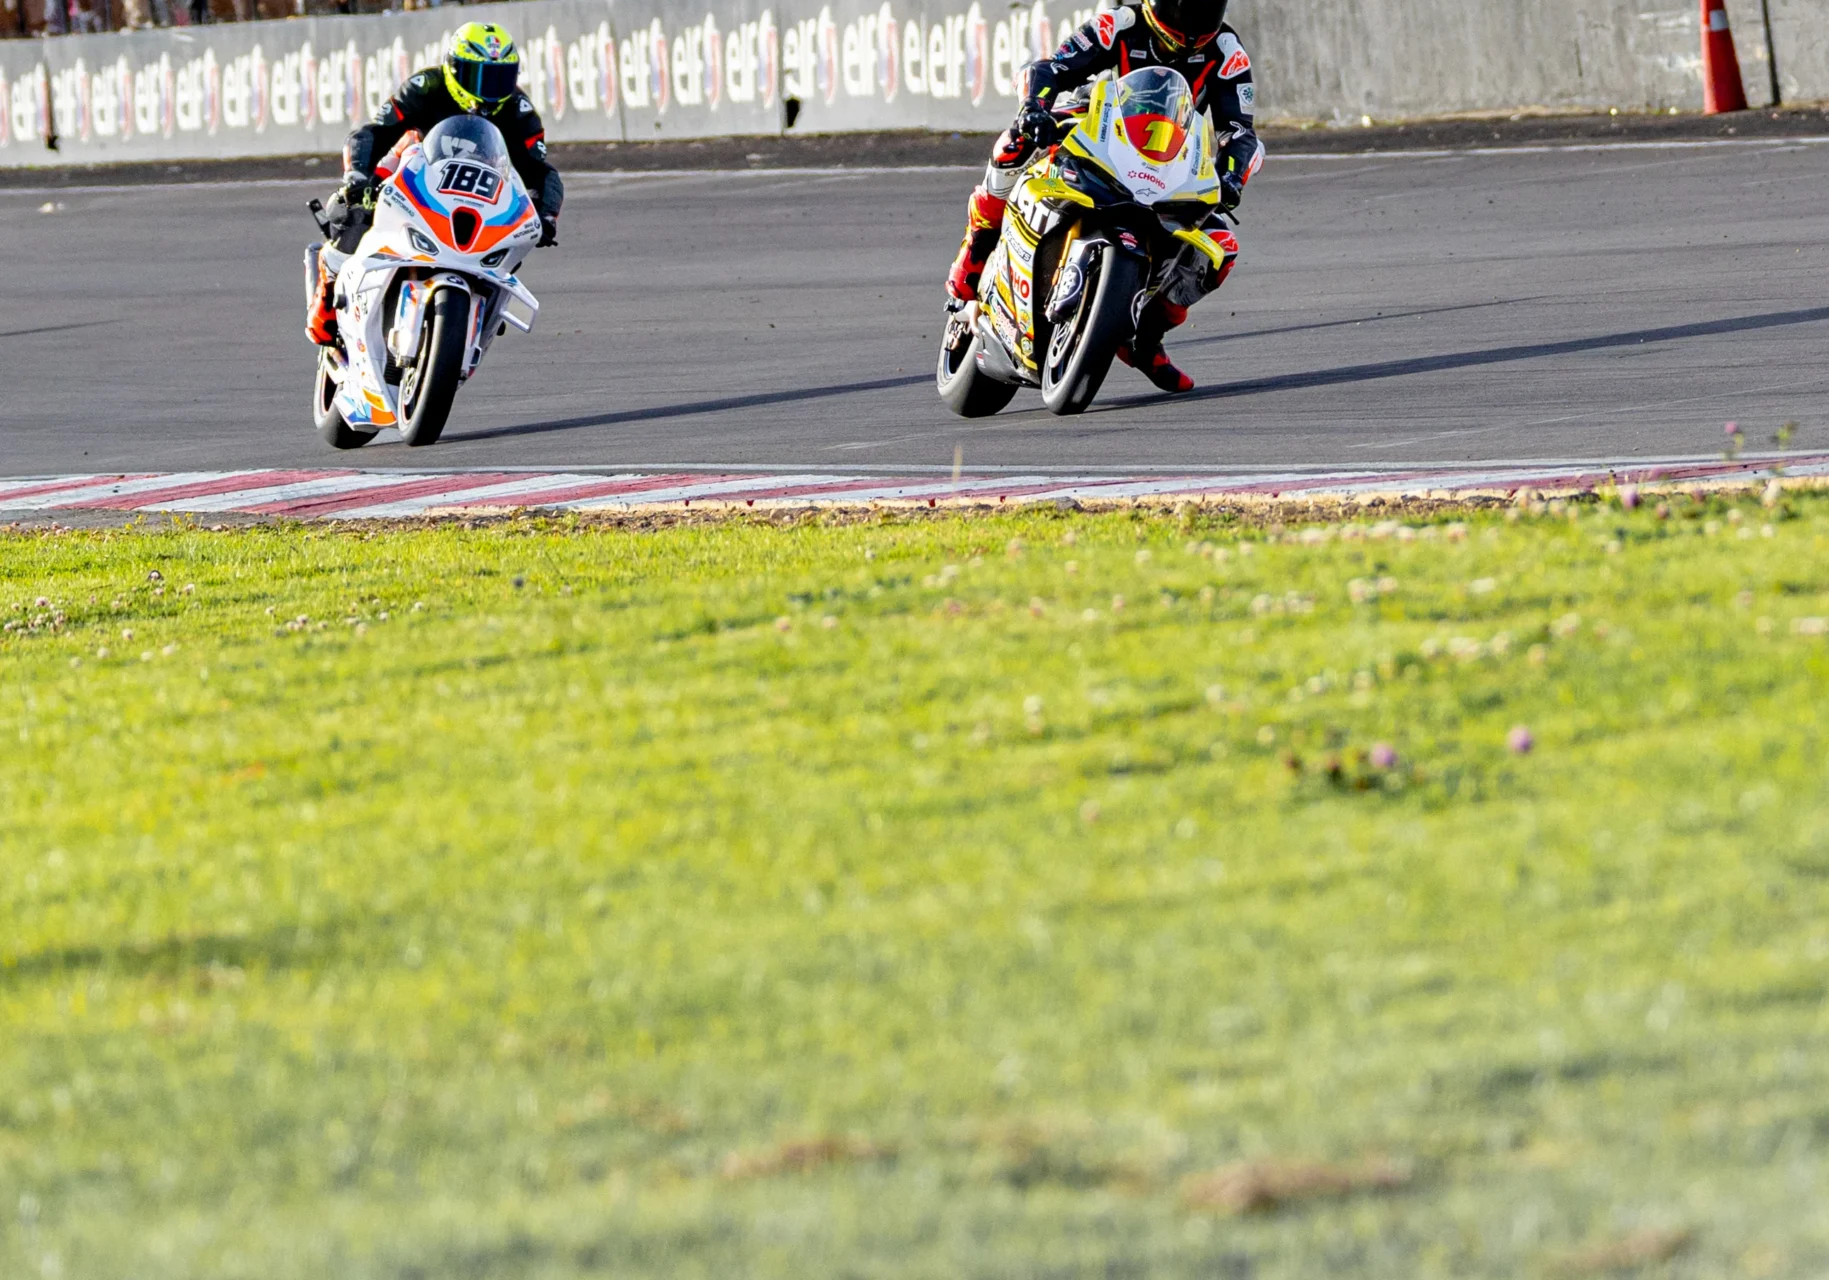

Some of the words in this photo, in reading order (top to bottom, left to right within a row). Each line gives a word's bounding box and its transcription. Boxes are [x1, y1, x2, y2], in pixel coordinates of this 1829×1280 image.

[1142, 121, 1175, 153] 1
[438, 162, 502, 200] 189
[1137, 171, 1167, 190] CHOHO
